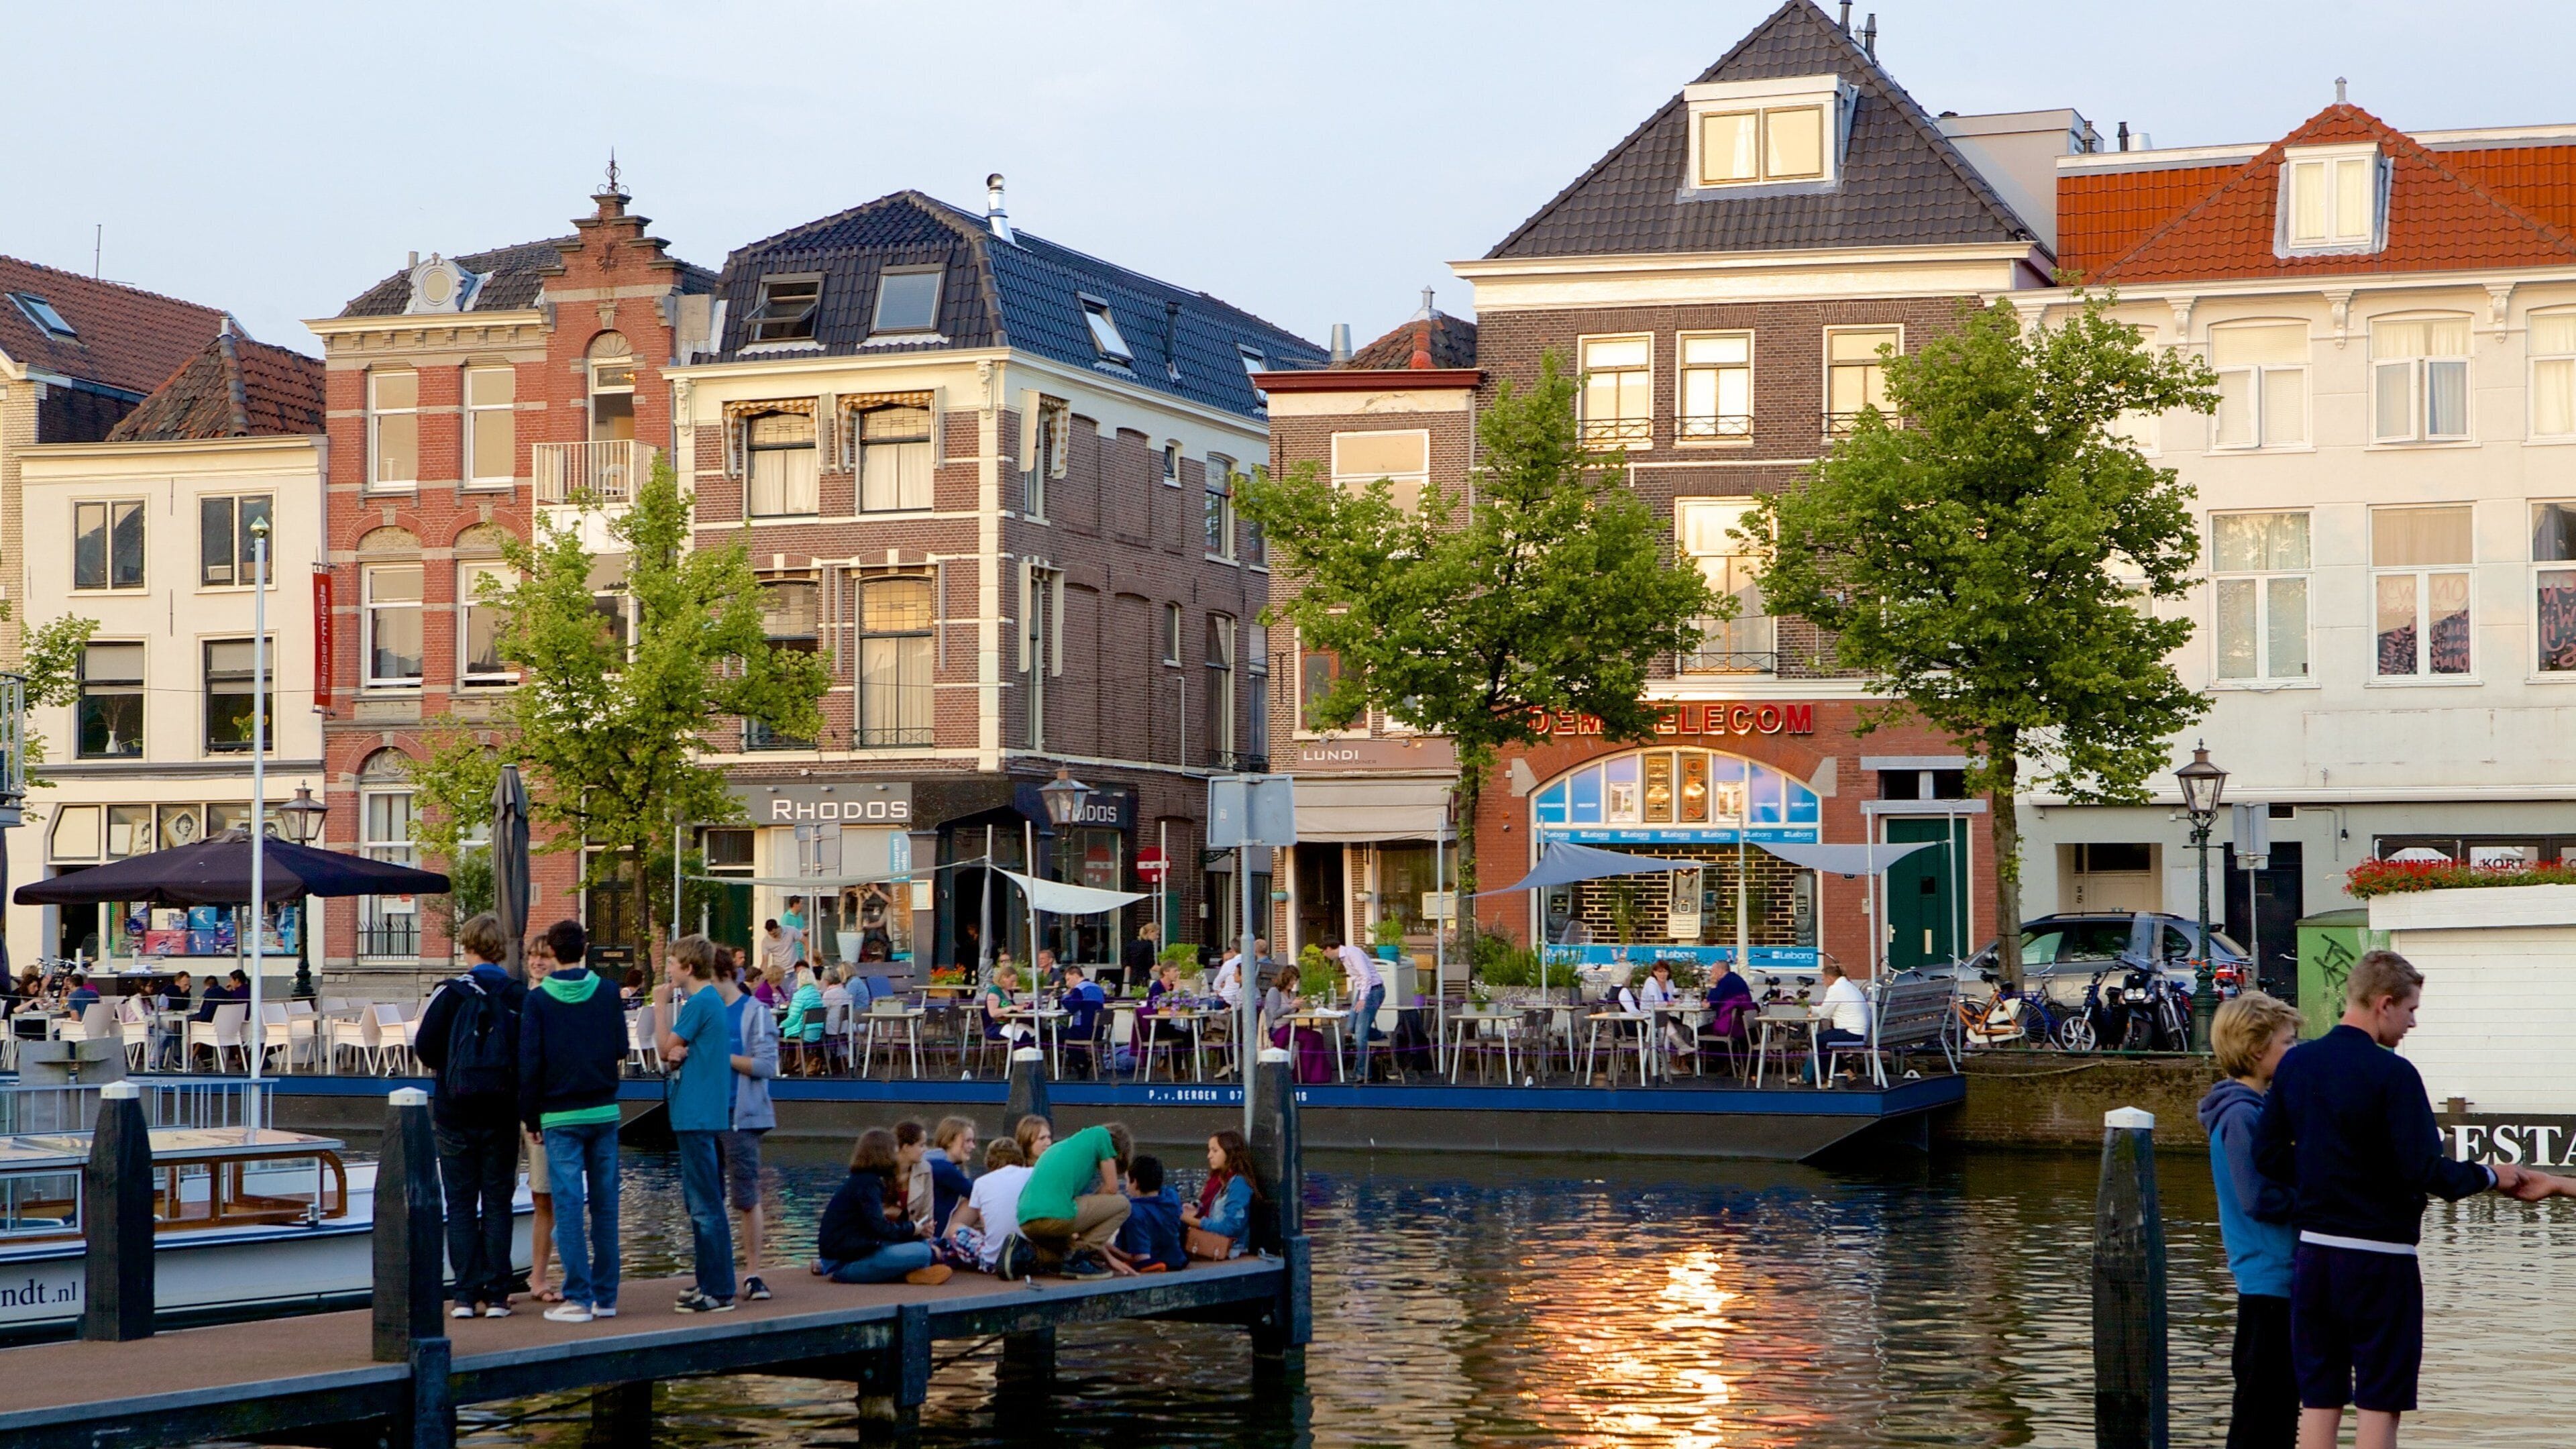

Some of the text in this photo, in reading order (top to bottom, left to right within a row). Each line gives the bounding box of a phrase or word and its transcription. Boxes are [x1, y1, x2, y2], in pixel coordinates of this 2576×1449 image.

[1640, 704, 1813, 735] ELECOM
[1303, 749, 1359, 761] LUNDI
[772, 799, 908, 820] RHODOS
[2482, 858, 2526, 869] KORT
[1780, 951, 1814, 960] Lebara
[2437, 1124, 2576, 1167] EST
